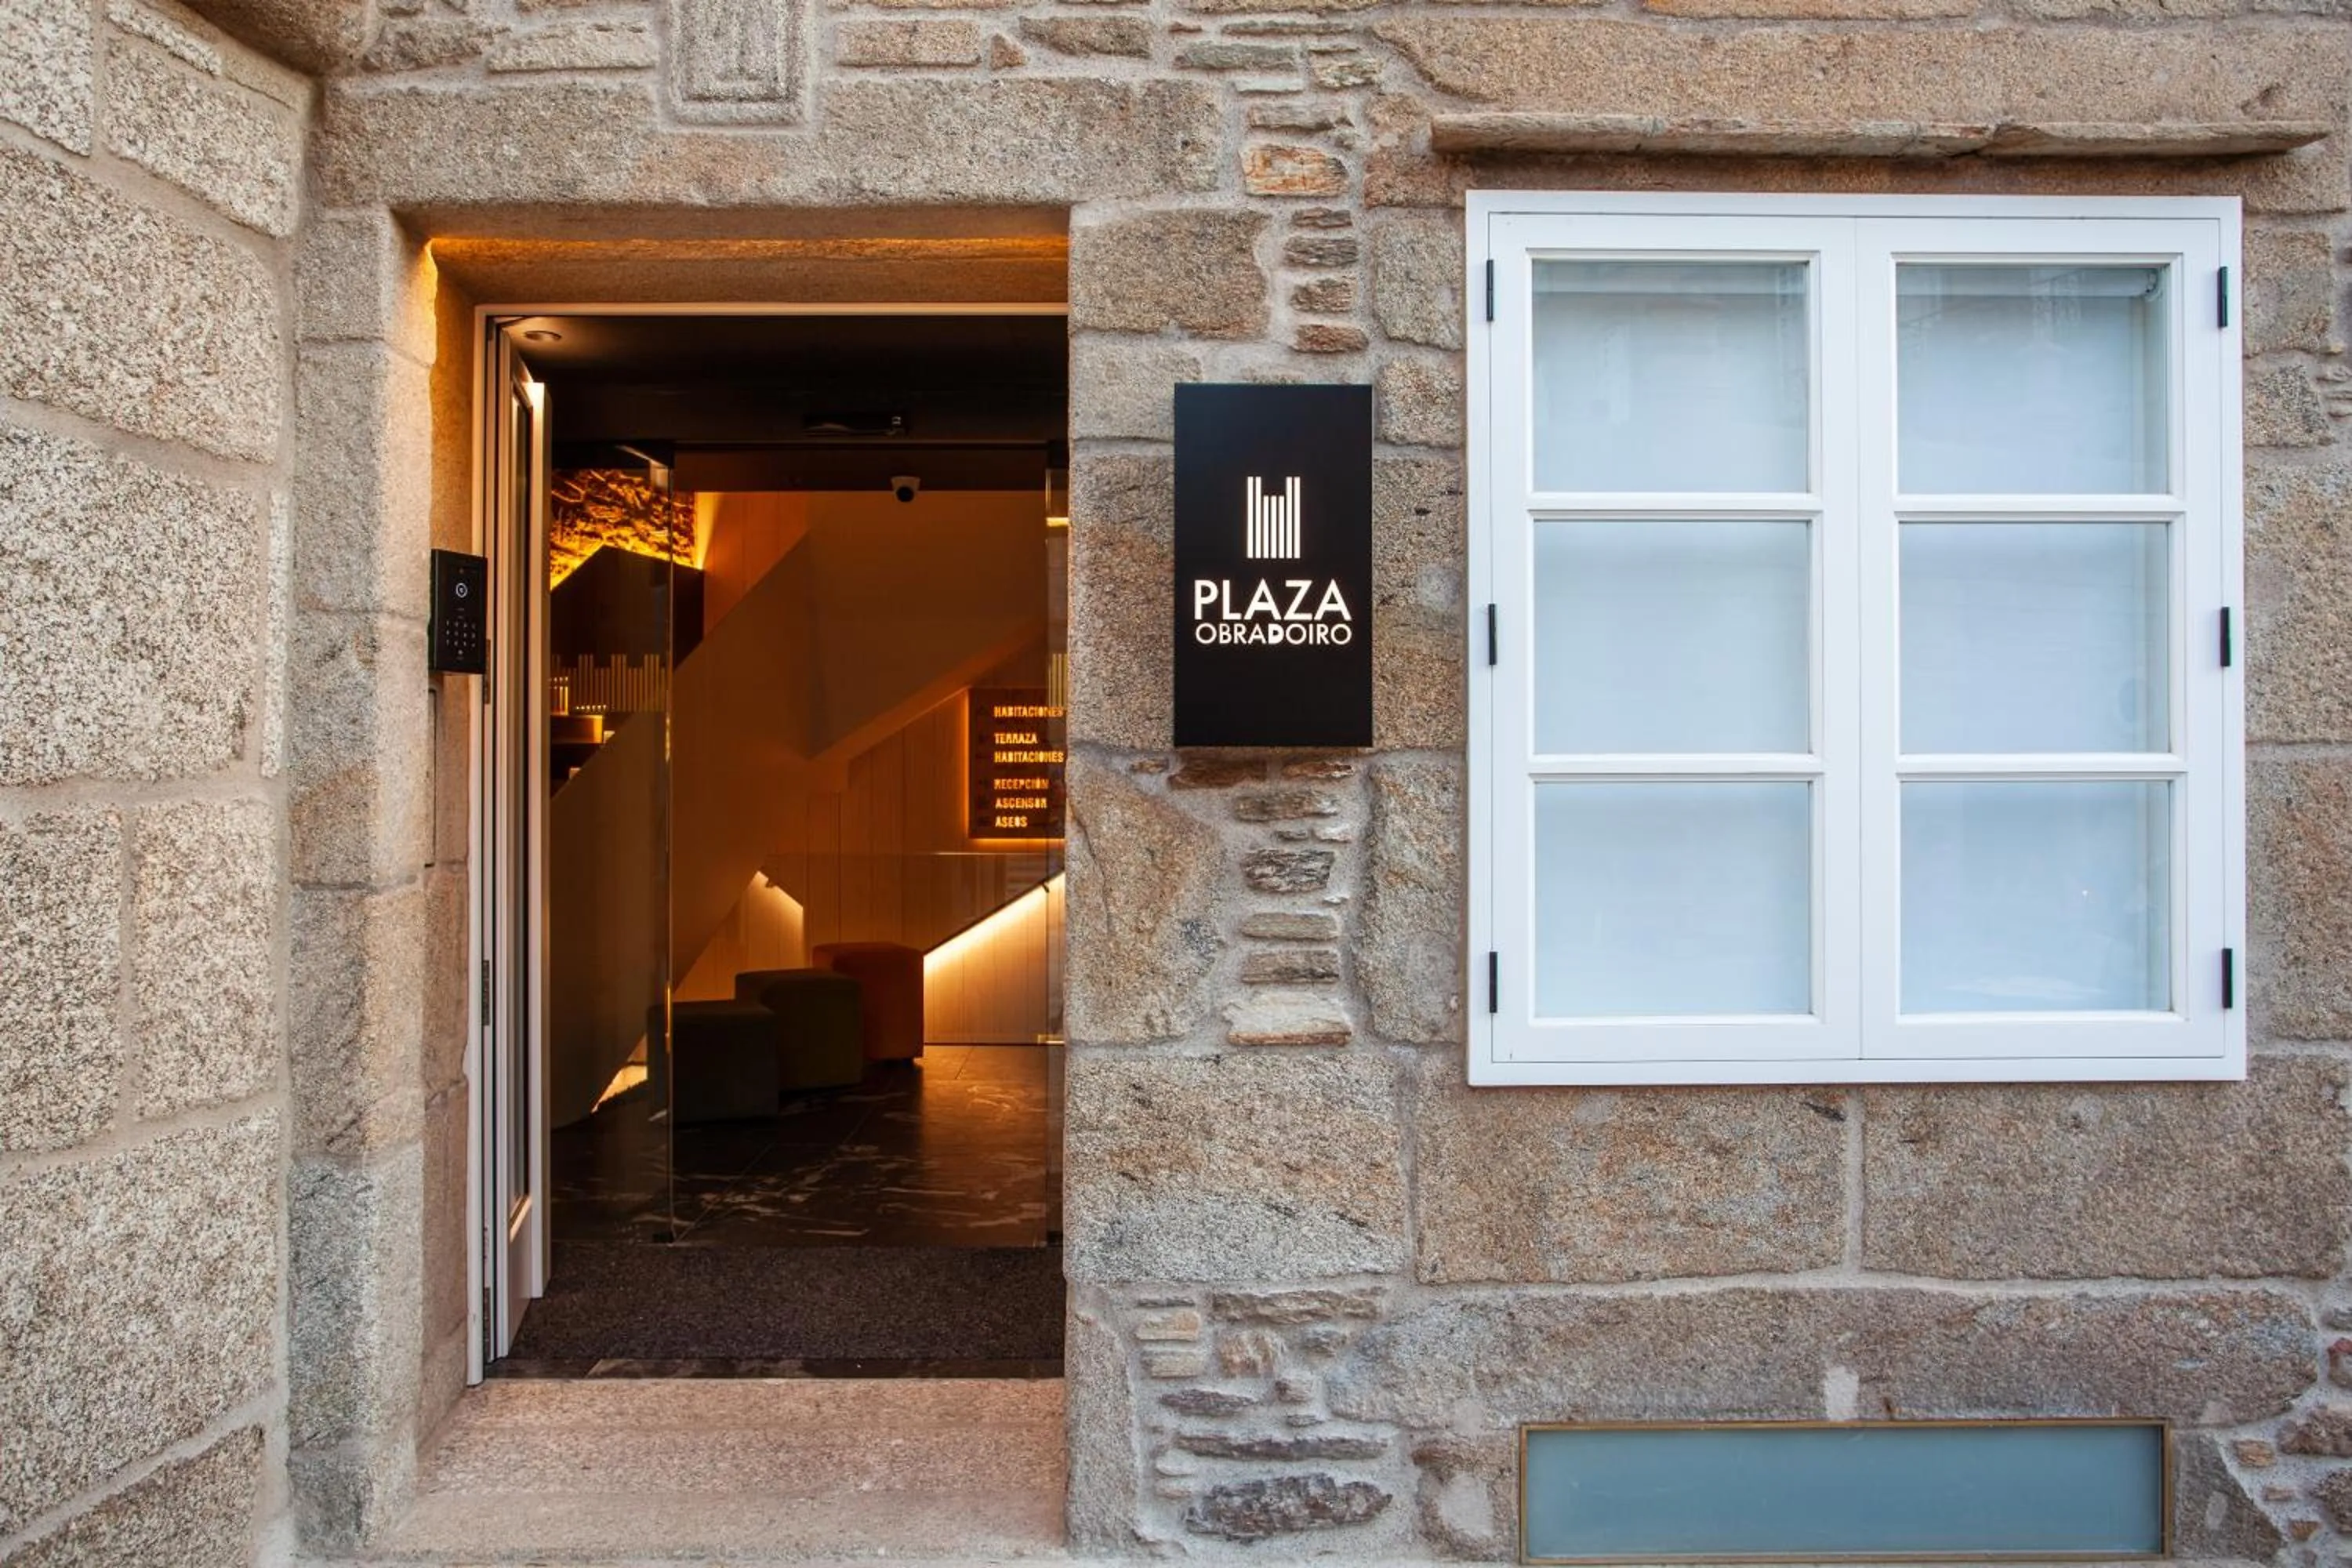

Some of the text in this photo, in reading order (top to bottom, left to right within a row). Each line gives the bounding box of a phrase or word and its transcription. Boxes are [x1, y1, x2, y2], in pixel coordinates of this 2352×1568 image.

[1194, 579, 1352, 620] PLAZA
[1195, 622, 1352, 645] OBRADOIRO
[994, 733, 1038, 744] TERRAZA
[994, 751, 1064, 763] HABITACIONES
[995, 797, 1047, 808] ASCENSOR
[995, 816, 1028, 827] ASEOS
